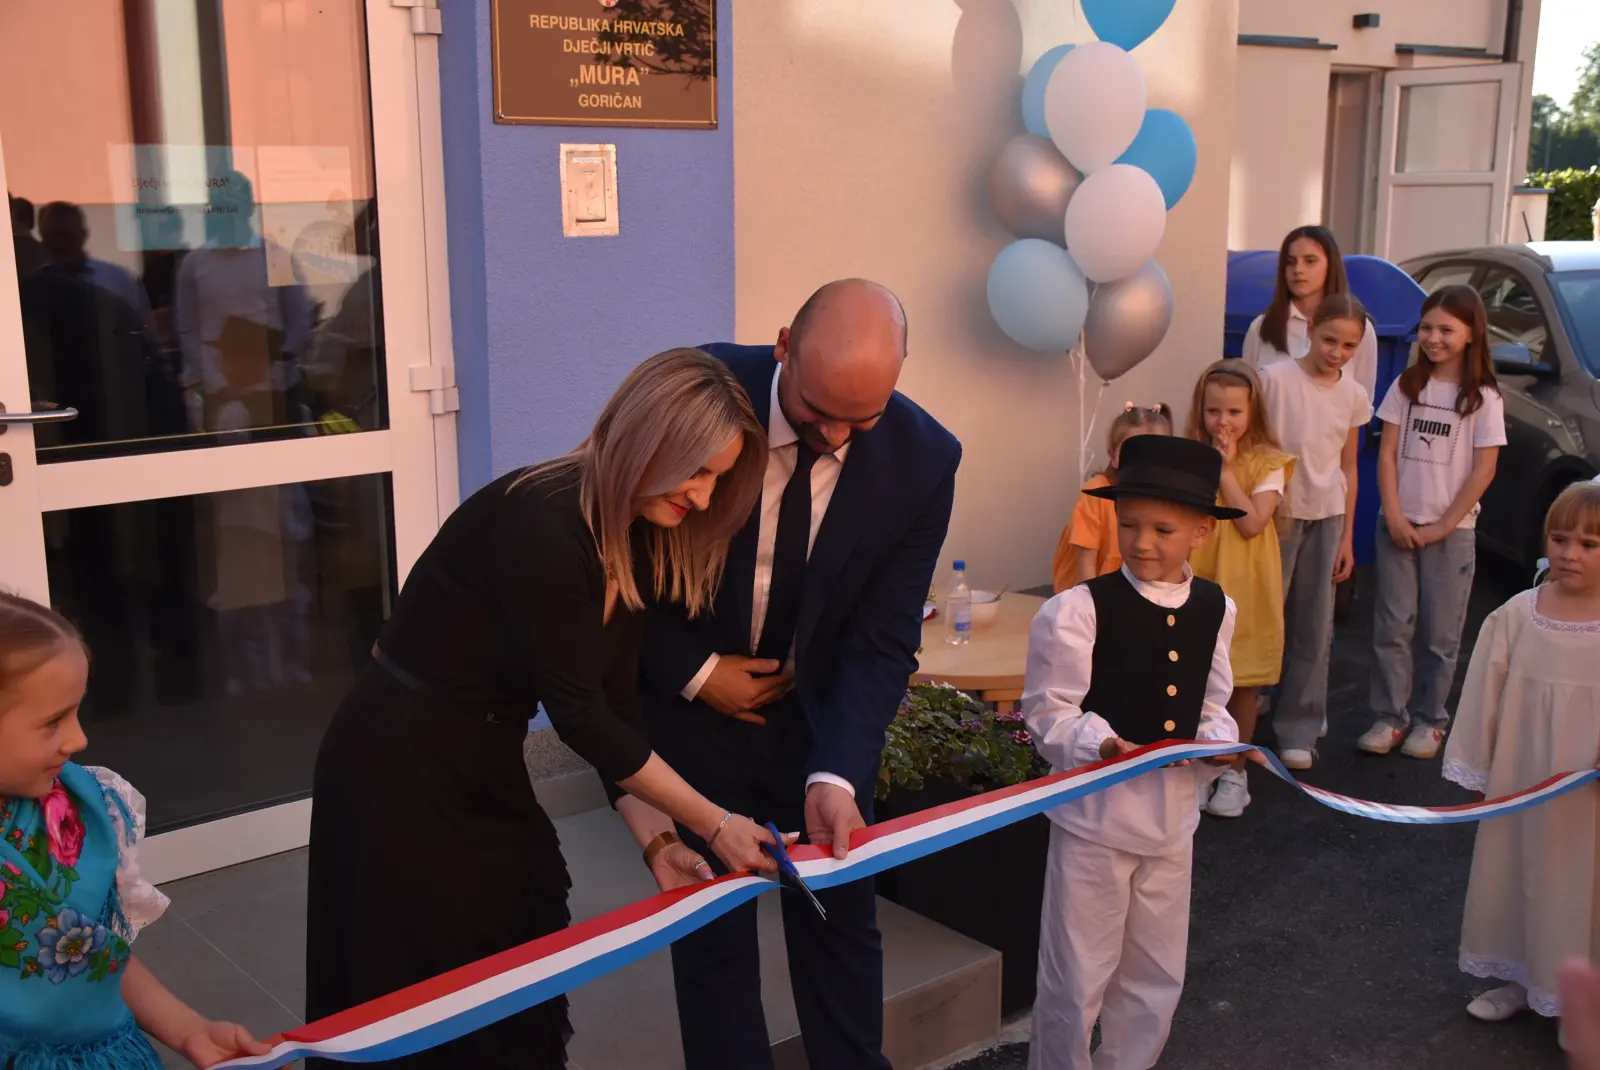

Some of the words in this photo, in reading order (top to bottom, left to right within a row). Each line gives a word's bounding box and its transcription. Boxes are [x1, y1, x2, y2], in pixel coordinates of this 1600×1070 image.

[529, 14, 611, 33] REPUBLIKA
[613, 20, 685, 37] HRVATSKA
[563, 37, 611, 55] DJEČJI
[615, 40, 654, 57] VRTIĆ
[578, 92, 642, 109] GORIČAN
[1412, 418, 1452, 437] PUMA
